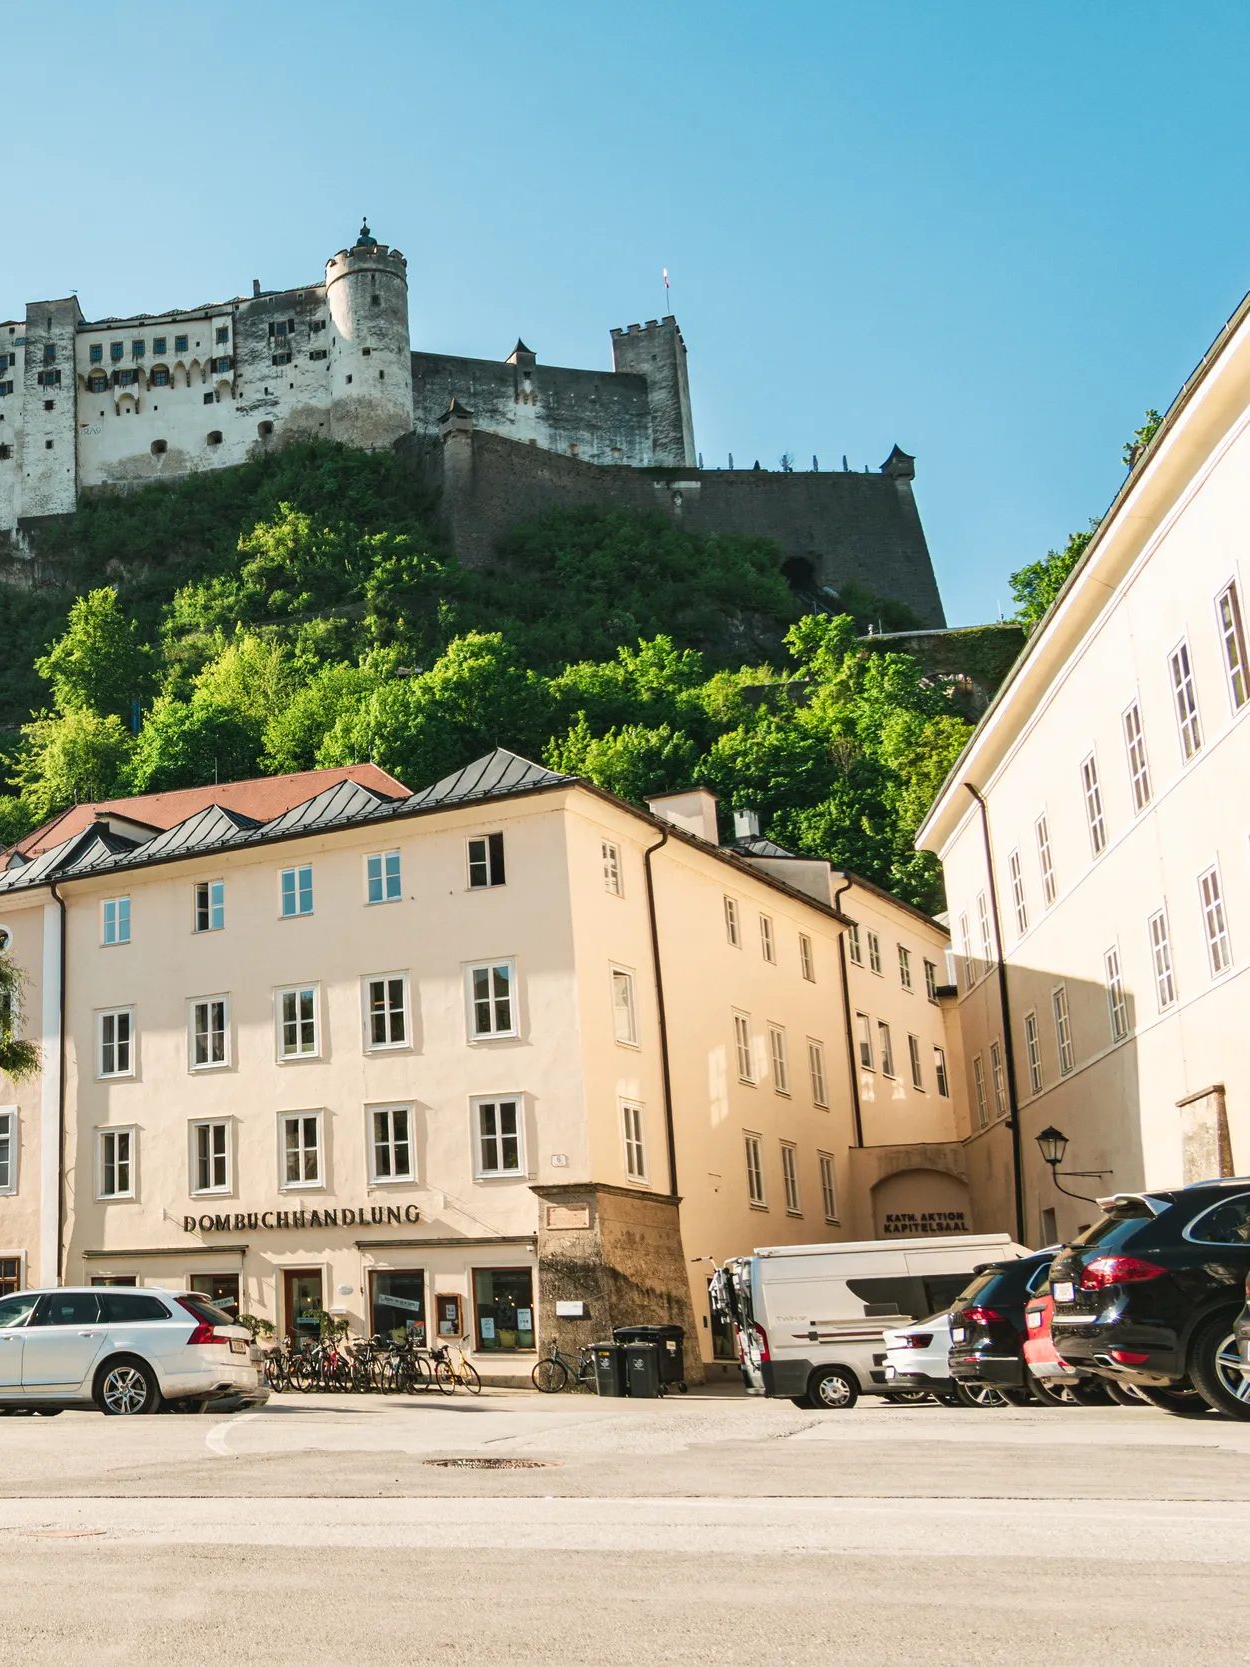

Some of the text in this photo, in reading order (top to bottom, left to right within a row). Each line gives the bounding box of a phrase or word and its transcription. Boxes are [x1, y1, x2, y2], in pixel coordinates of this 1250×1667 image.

[183, 1204, 421, 1233] DOMBUCHHANDLUNG
[886, 1211, 964, 1223] KATH. AKTION
[883, 1221, 969, 1233] KAPITELSAAL
